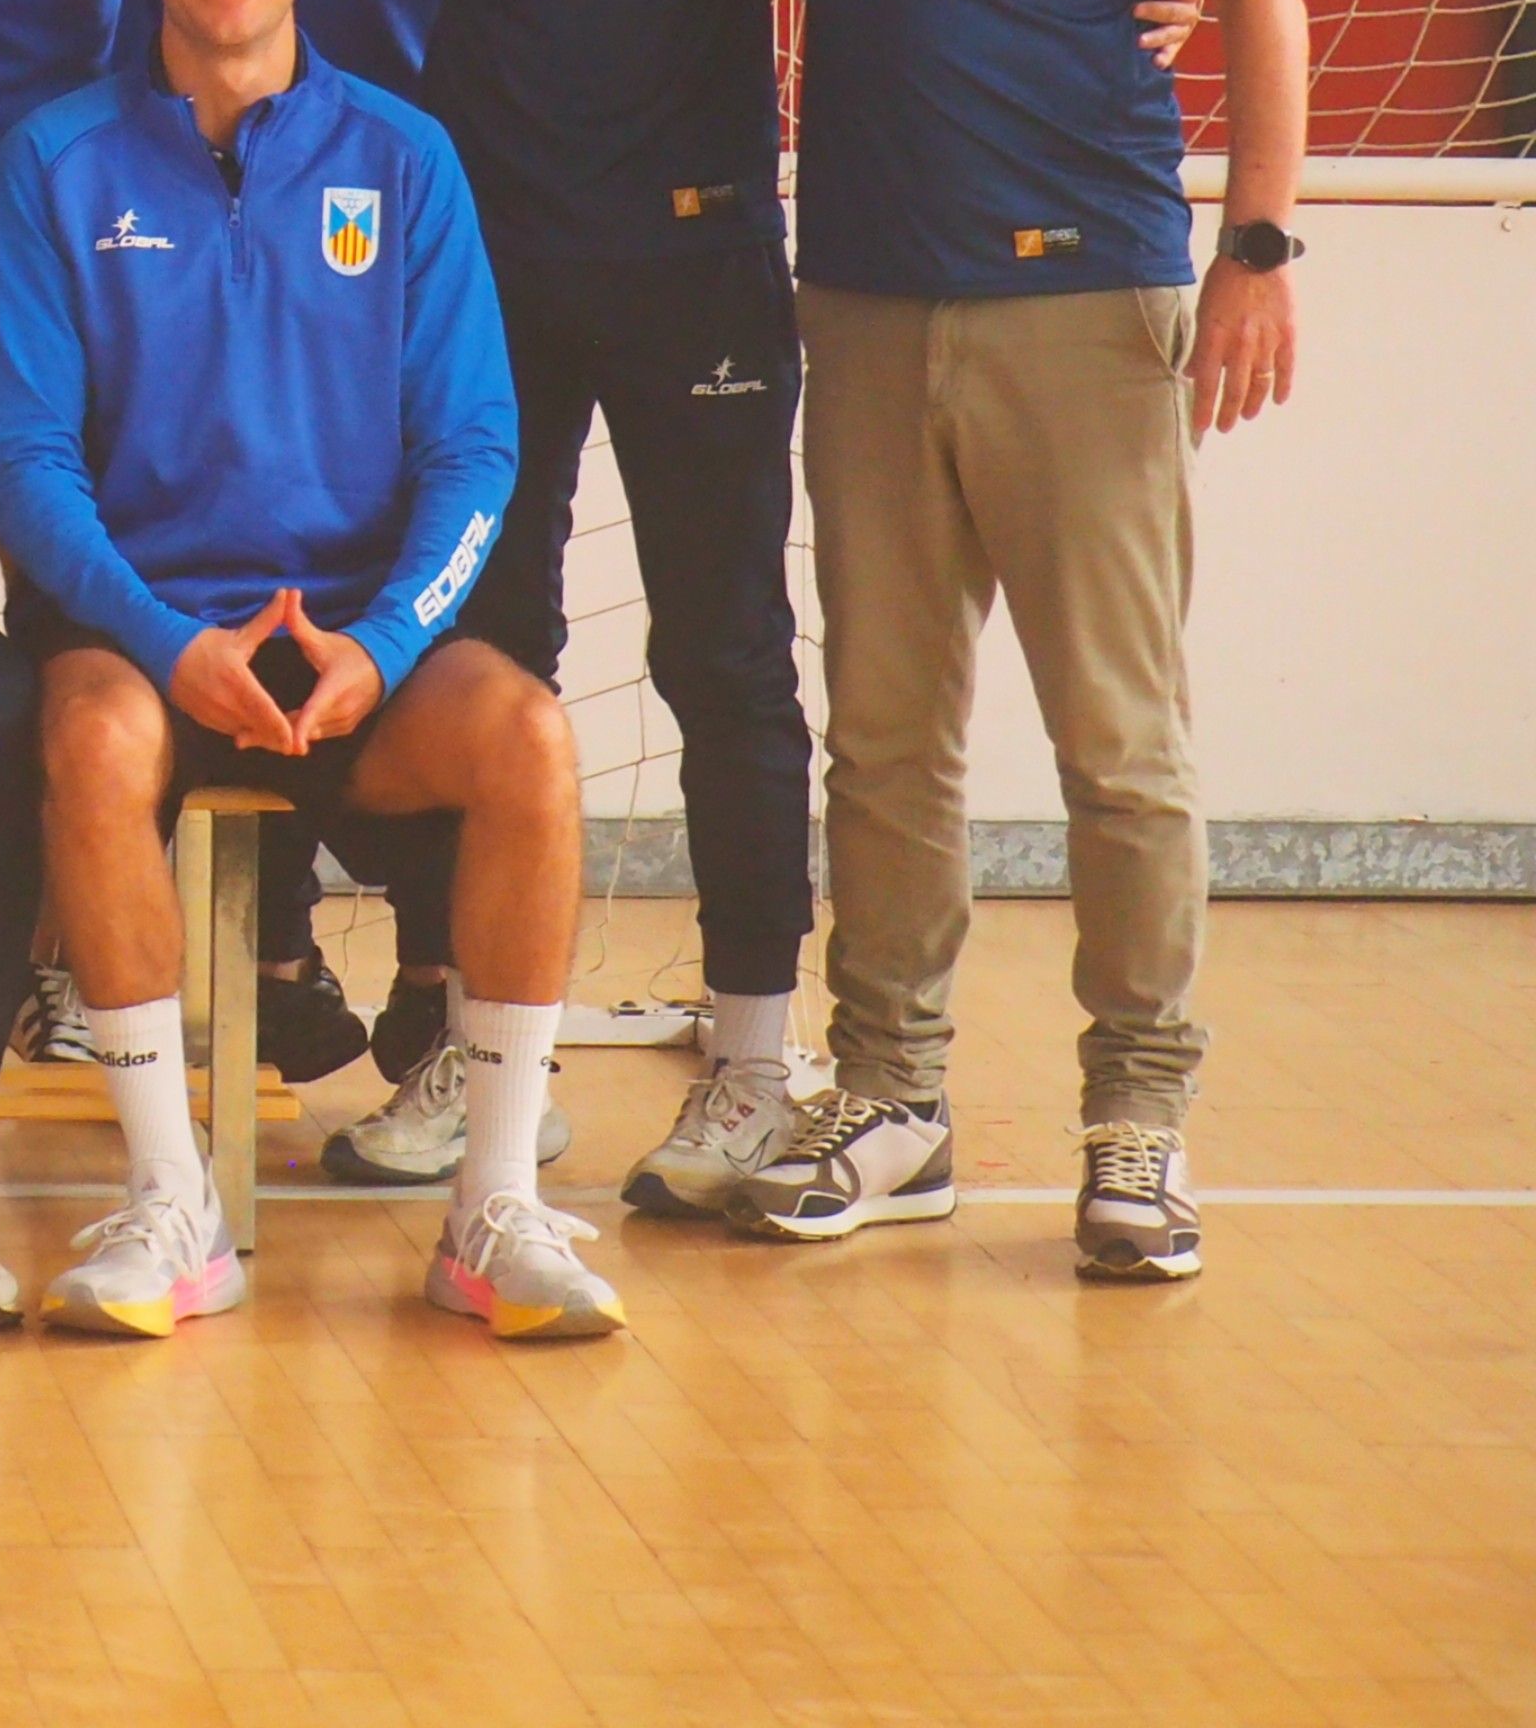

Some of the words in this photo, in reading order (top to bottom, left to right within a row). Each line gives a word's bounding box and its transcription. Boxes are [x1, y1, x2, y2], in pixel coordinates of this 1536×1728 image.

[95, 235, 176, 252] GLOBAL
[691, 379, 768, 396] GLOBAL
[99, 1050, 159, 1068] didas
